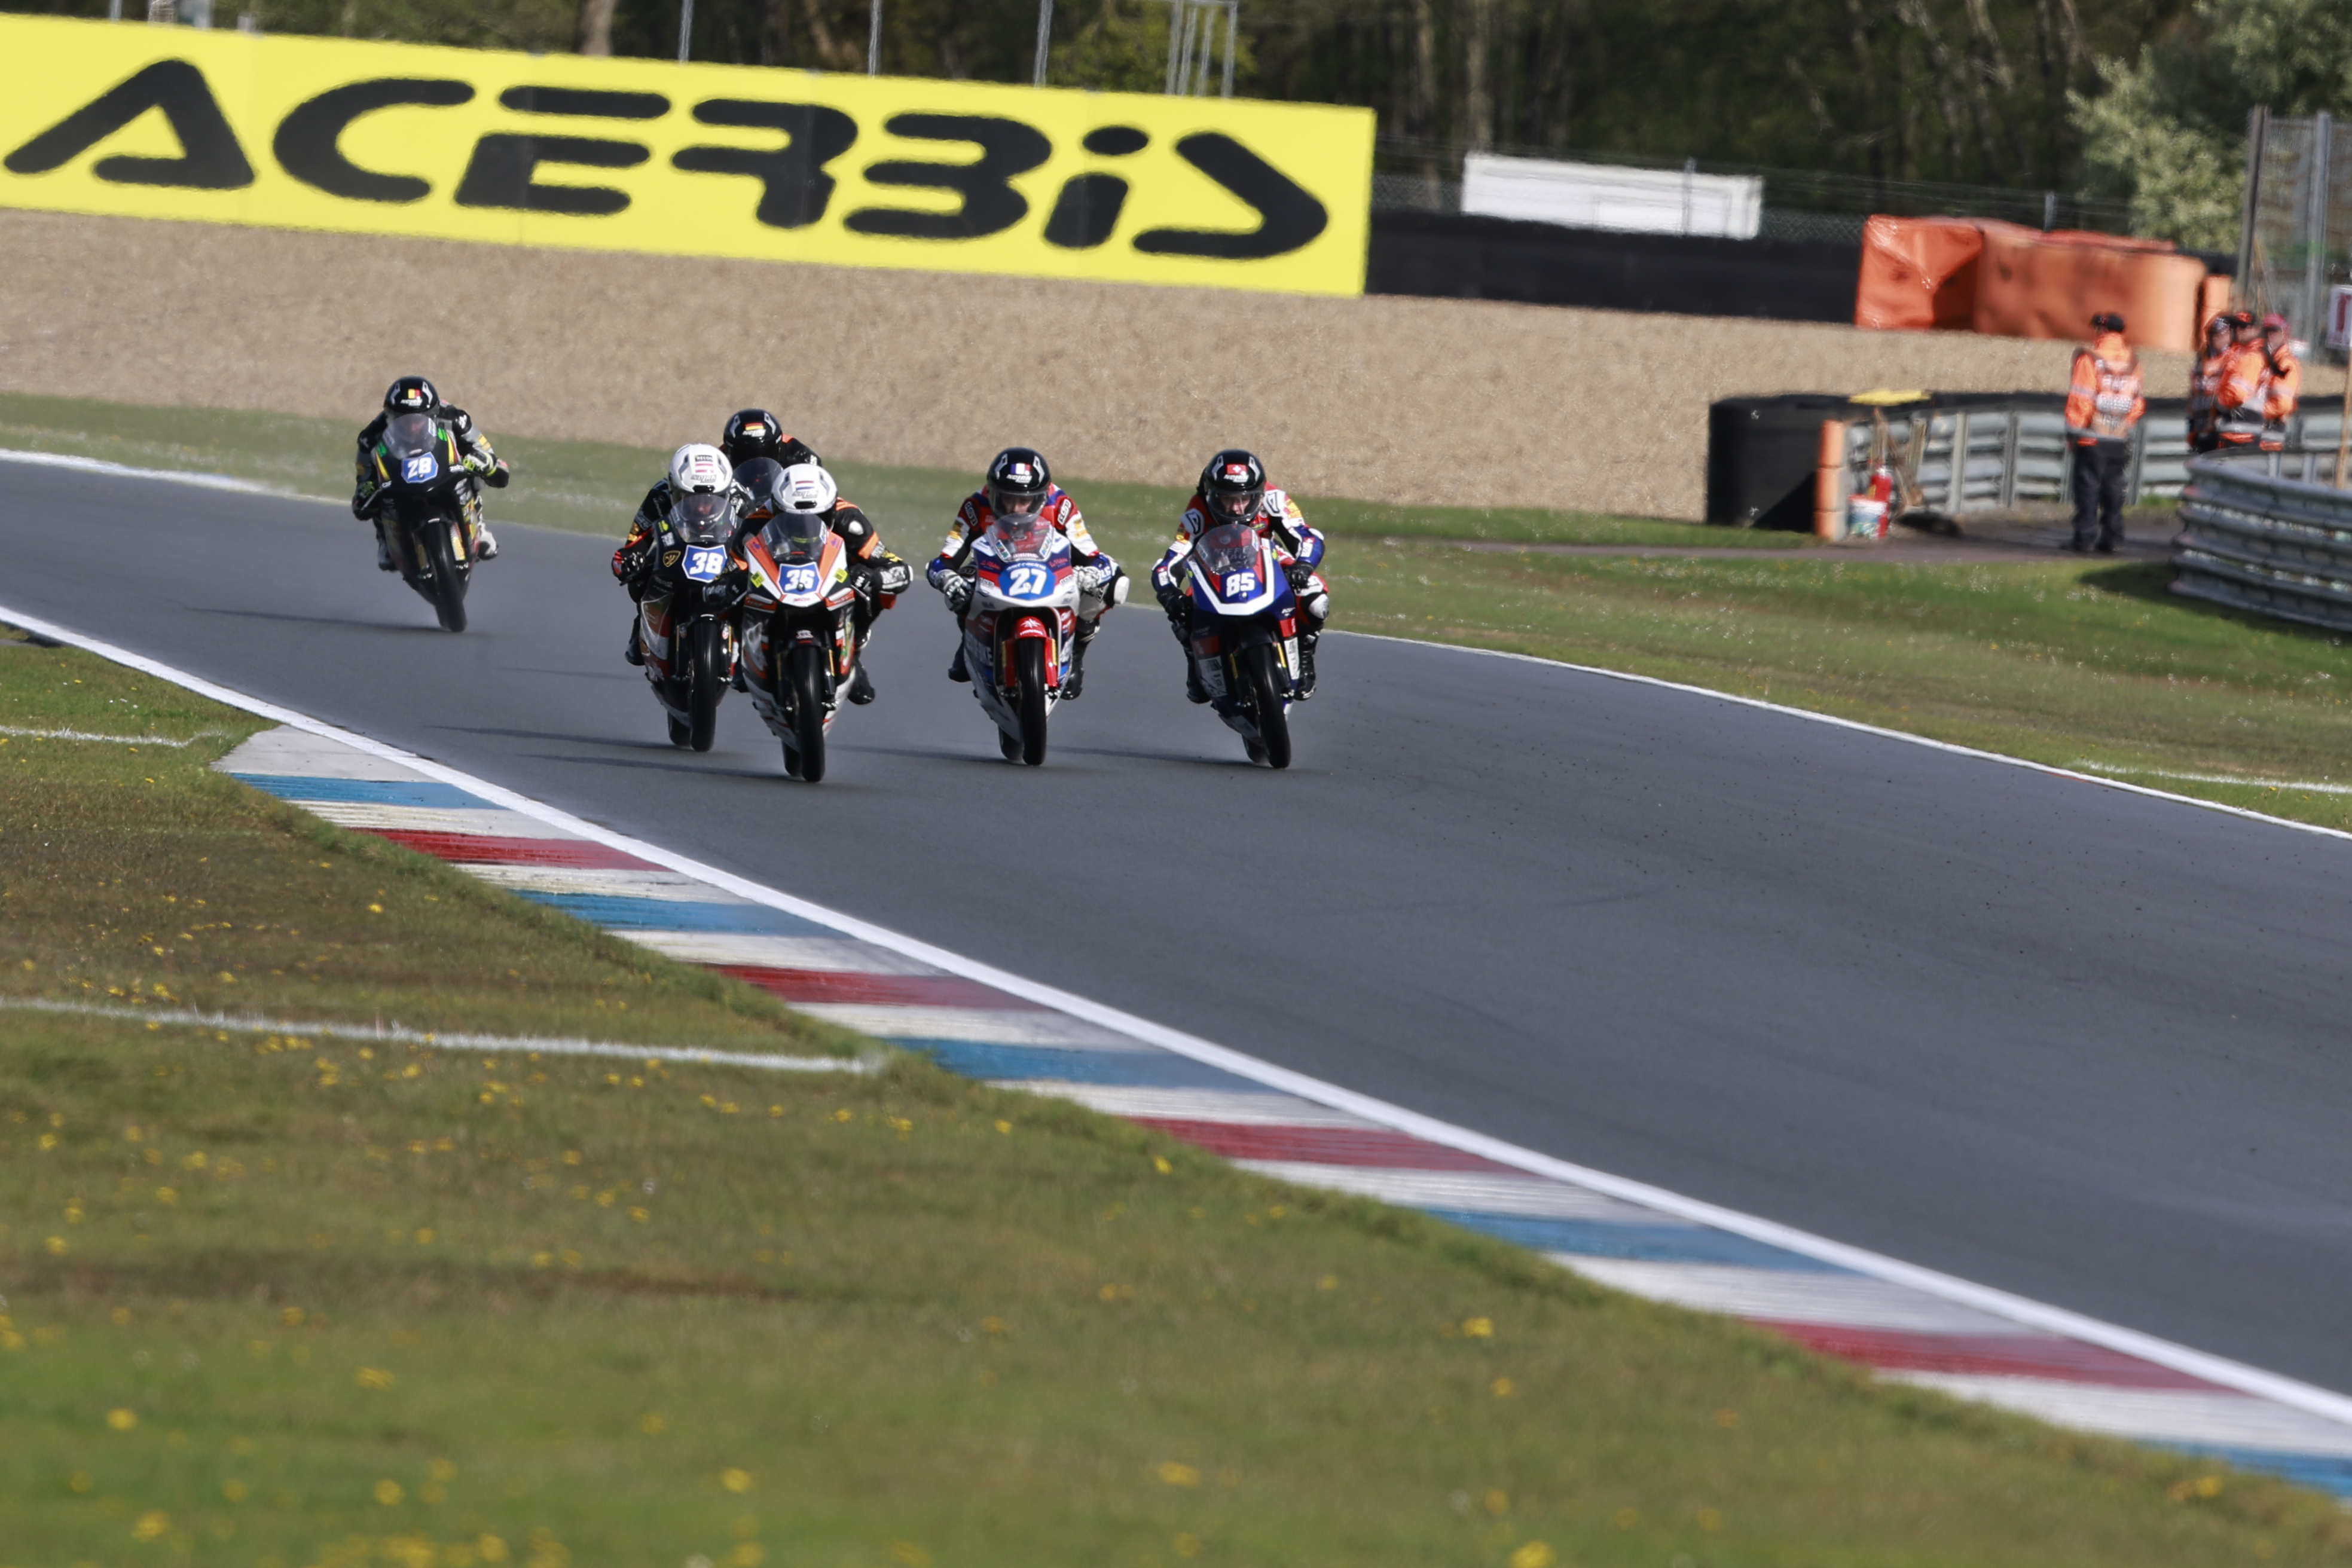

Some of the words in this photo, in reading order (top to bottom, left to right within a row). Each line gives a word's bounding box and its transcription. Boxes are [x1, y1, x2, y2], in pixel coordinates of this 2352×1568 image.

[4, 57, 1328, 259] ACERBIS
[408, 457, 432, 479] 28
[689, 552, 723, 574] 38
[784, 569, 815, 591] 36
[1009, 567, 1047, 596] 27
[1226, 573, 1255, 598] 85
